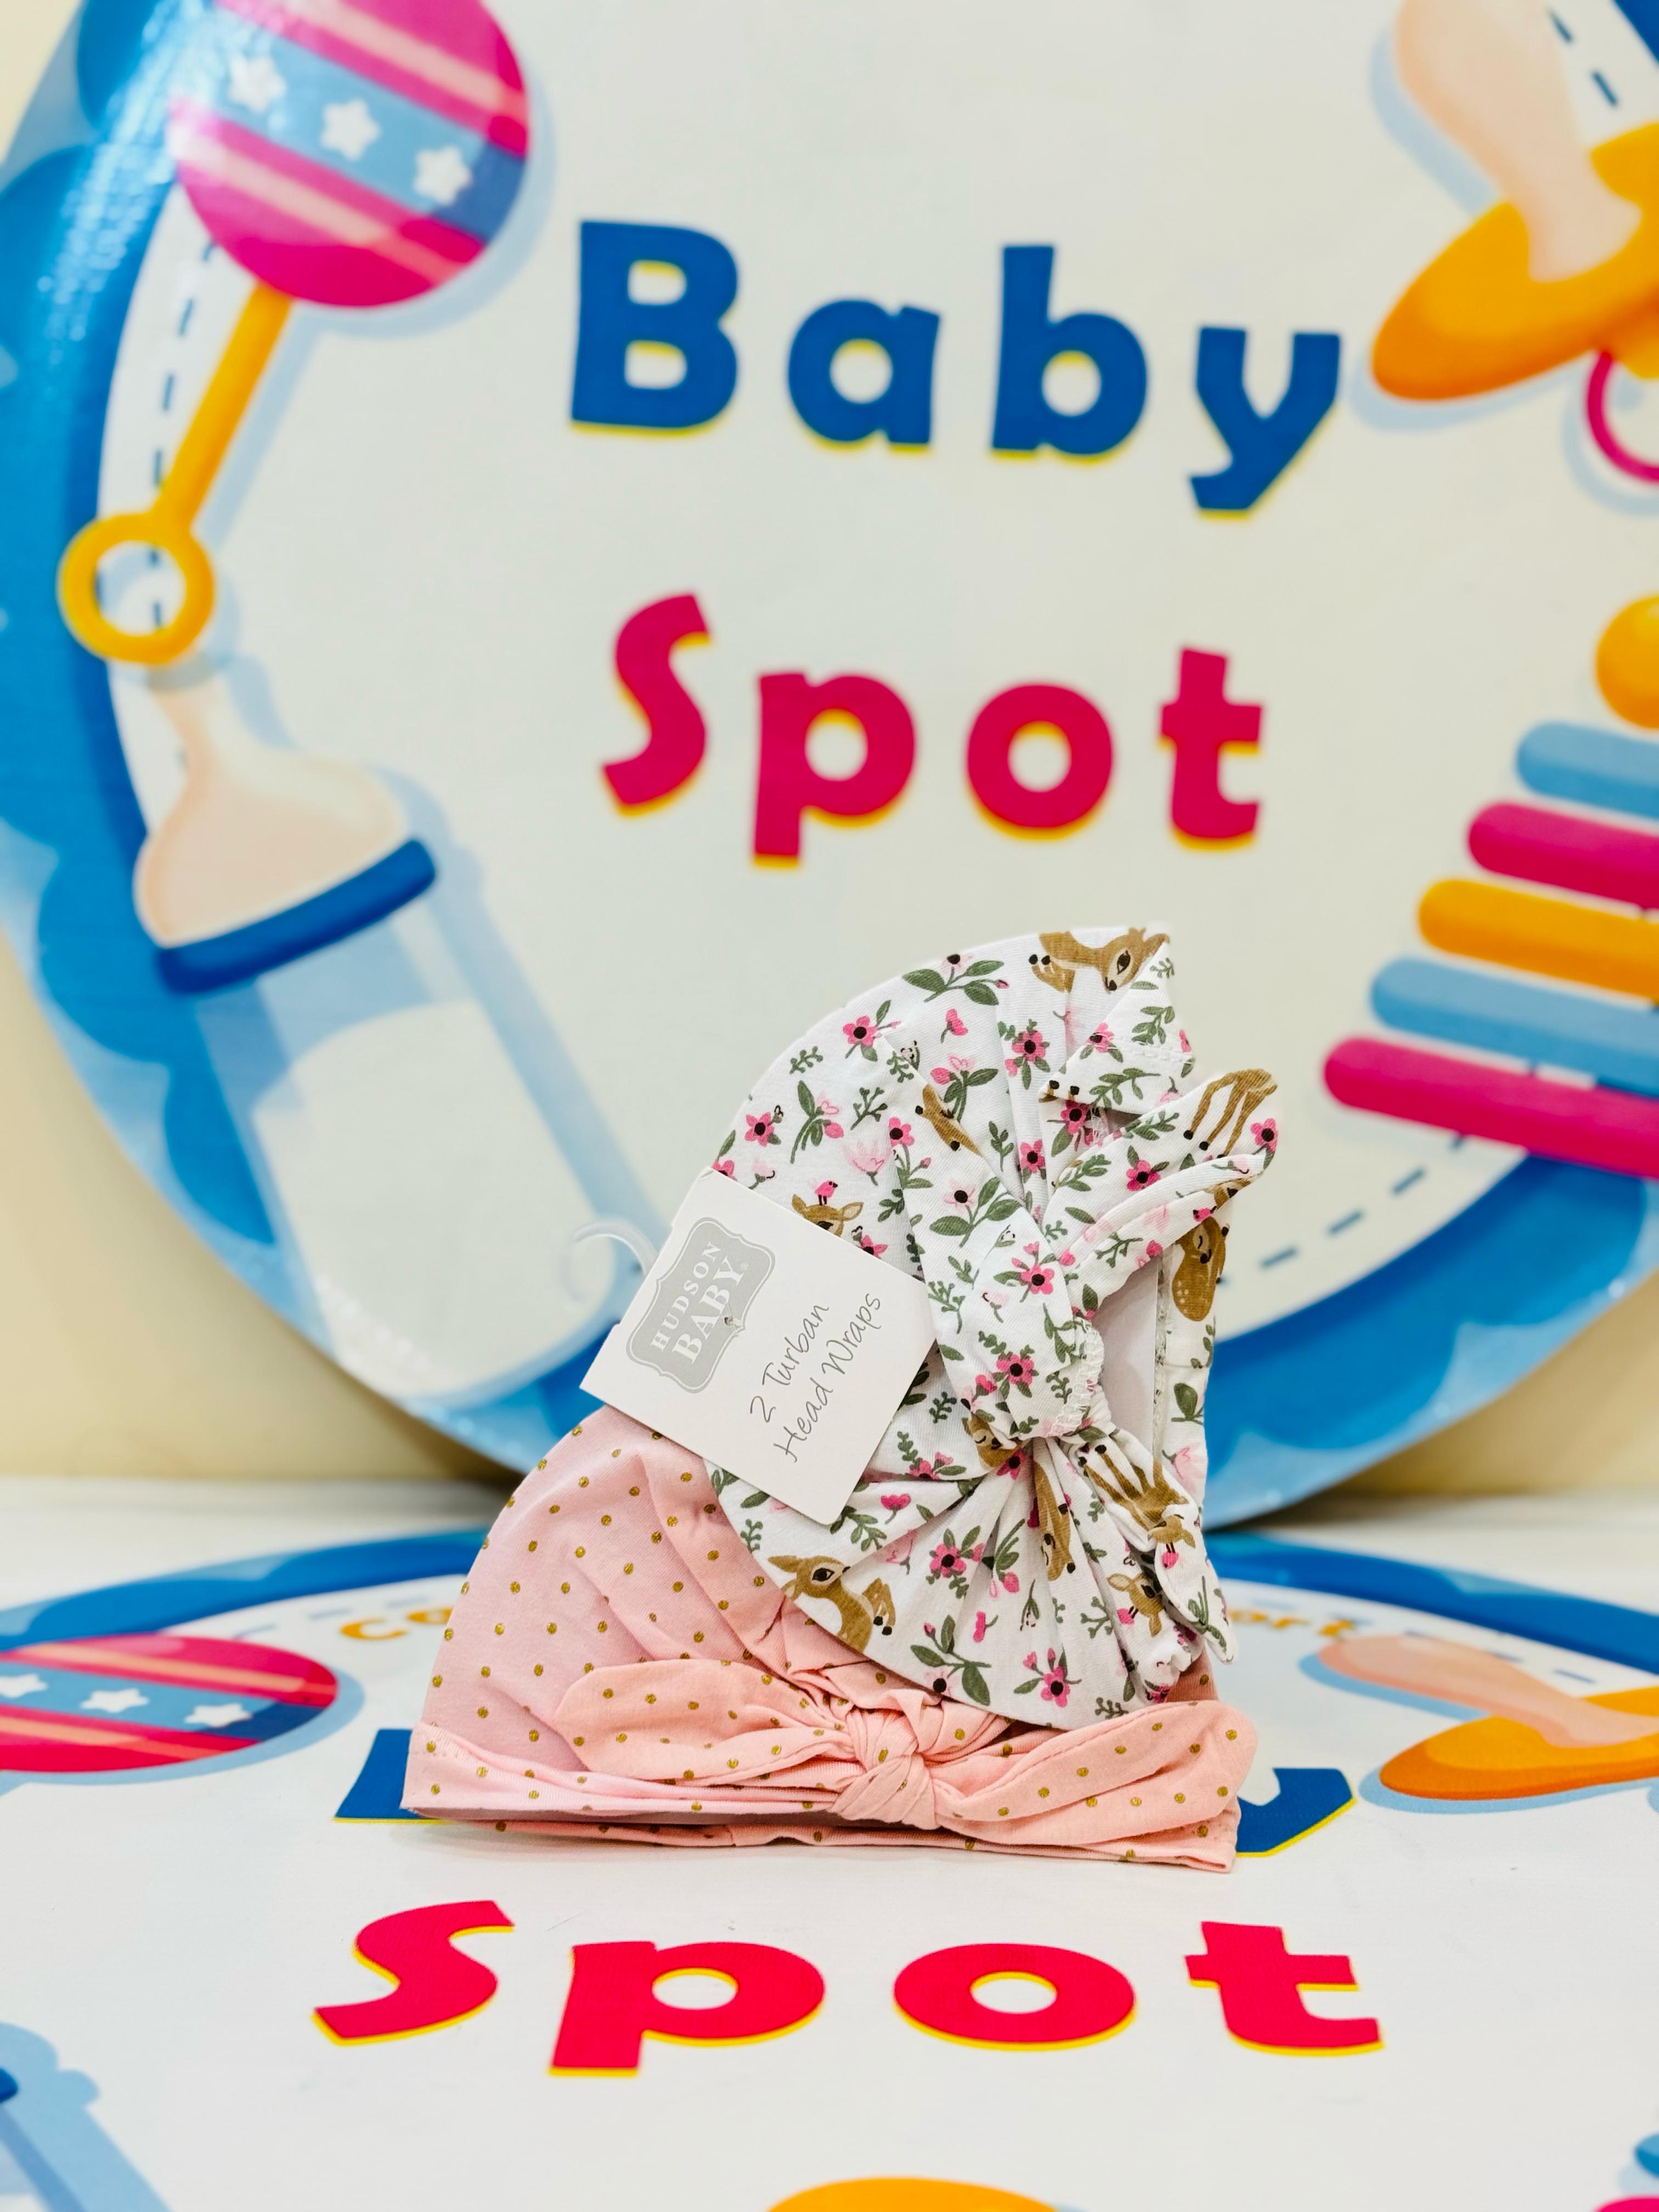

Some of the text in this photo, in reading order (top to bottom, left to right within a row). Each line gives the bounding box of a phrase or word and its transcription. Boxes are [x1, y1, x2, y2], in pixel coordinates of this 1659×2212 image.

[569, 218, 1342, 520] Baby
[600, 592, 1264, 869] Spot
[650, 1240, 721, 1352] HUDSON
[672, 1255, 744, 1364] BABY
[749, 1305, 830, 1423] 2 Turban
[773, 1293, 882, 1463] Head Wraps
[312, 1899, 1386, 2078] Spot
